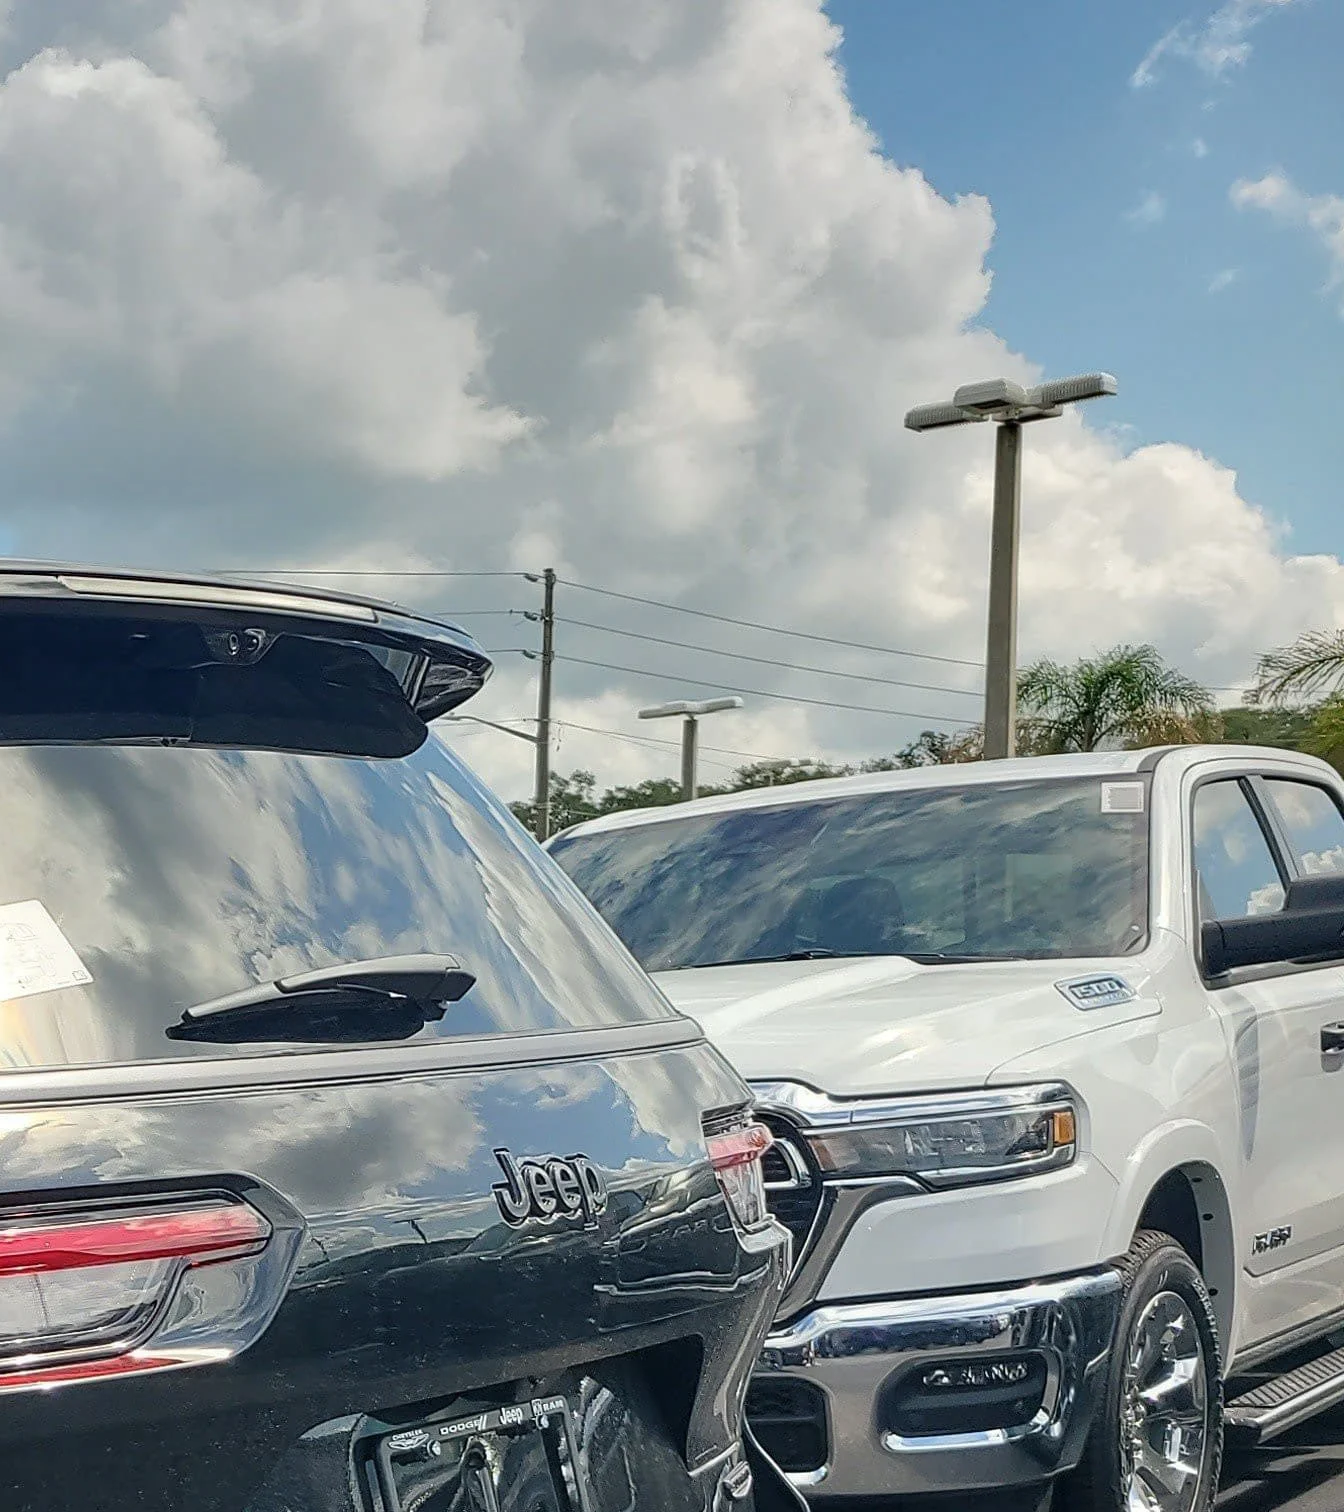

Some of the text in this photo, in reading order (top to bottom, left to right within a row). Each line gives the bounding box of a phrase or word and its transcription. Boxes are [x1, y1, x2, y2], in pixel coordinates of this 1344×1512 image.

[491, 1146, 611, 1230] Jeep
[499, 1407, 524, 1425] Jeep
[542, 1400, 564, 1412] RAM
